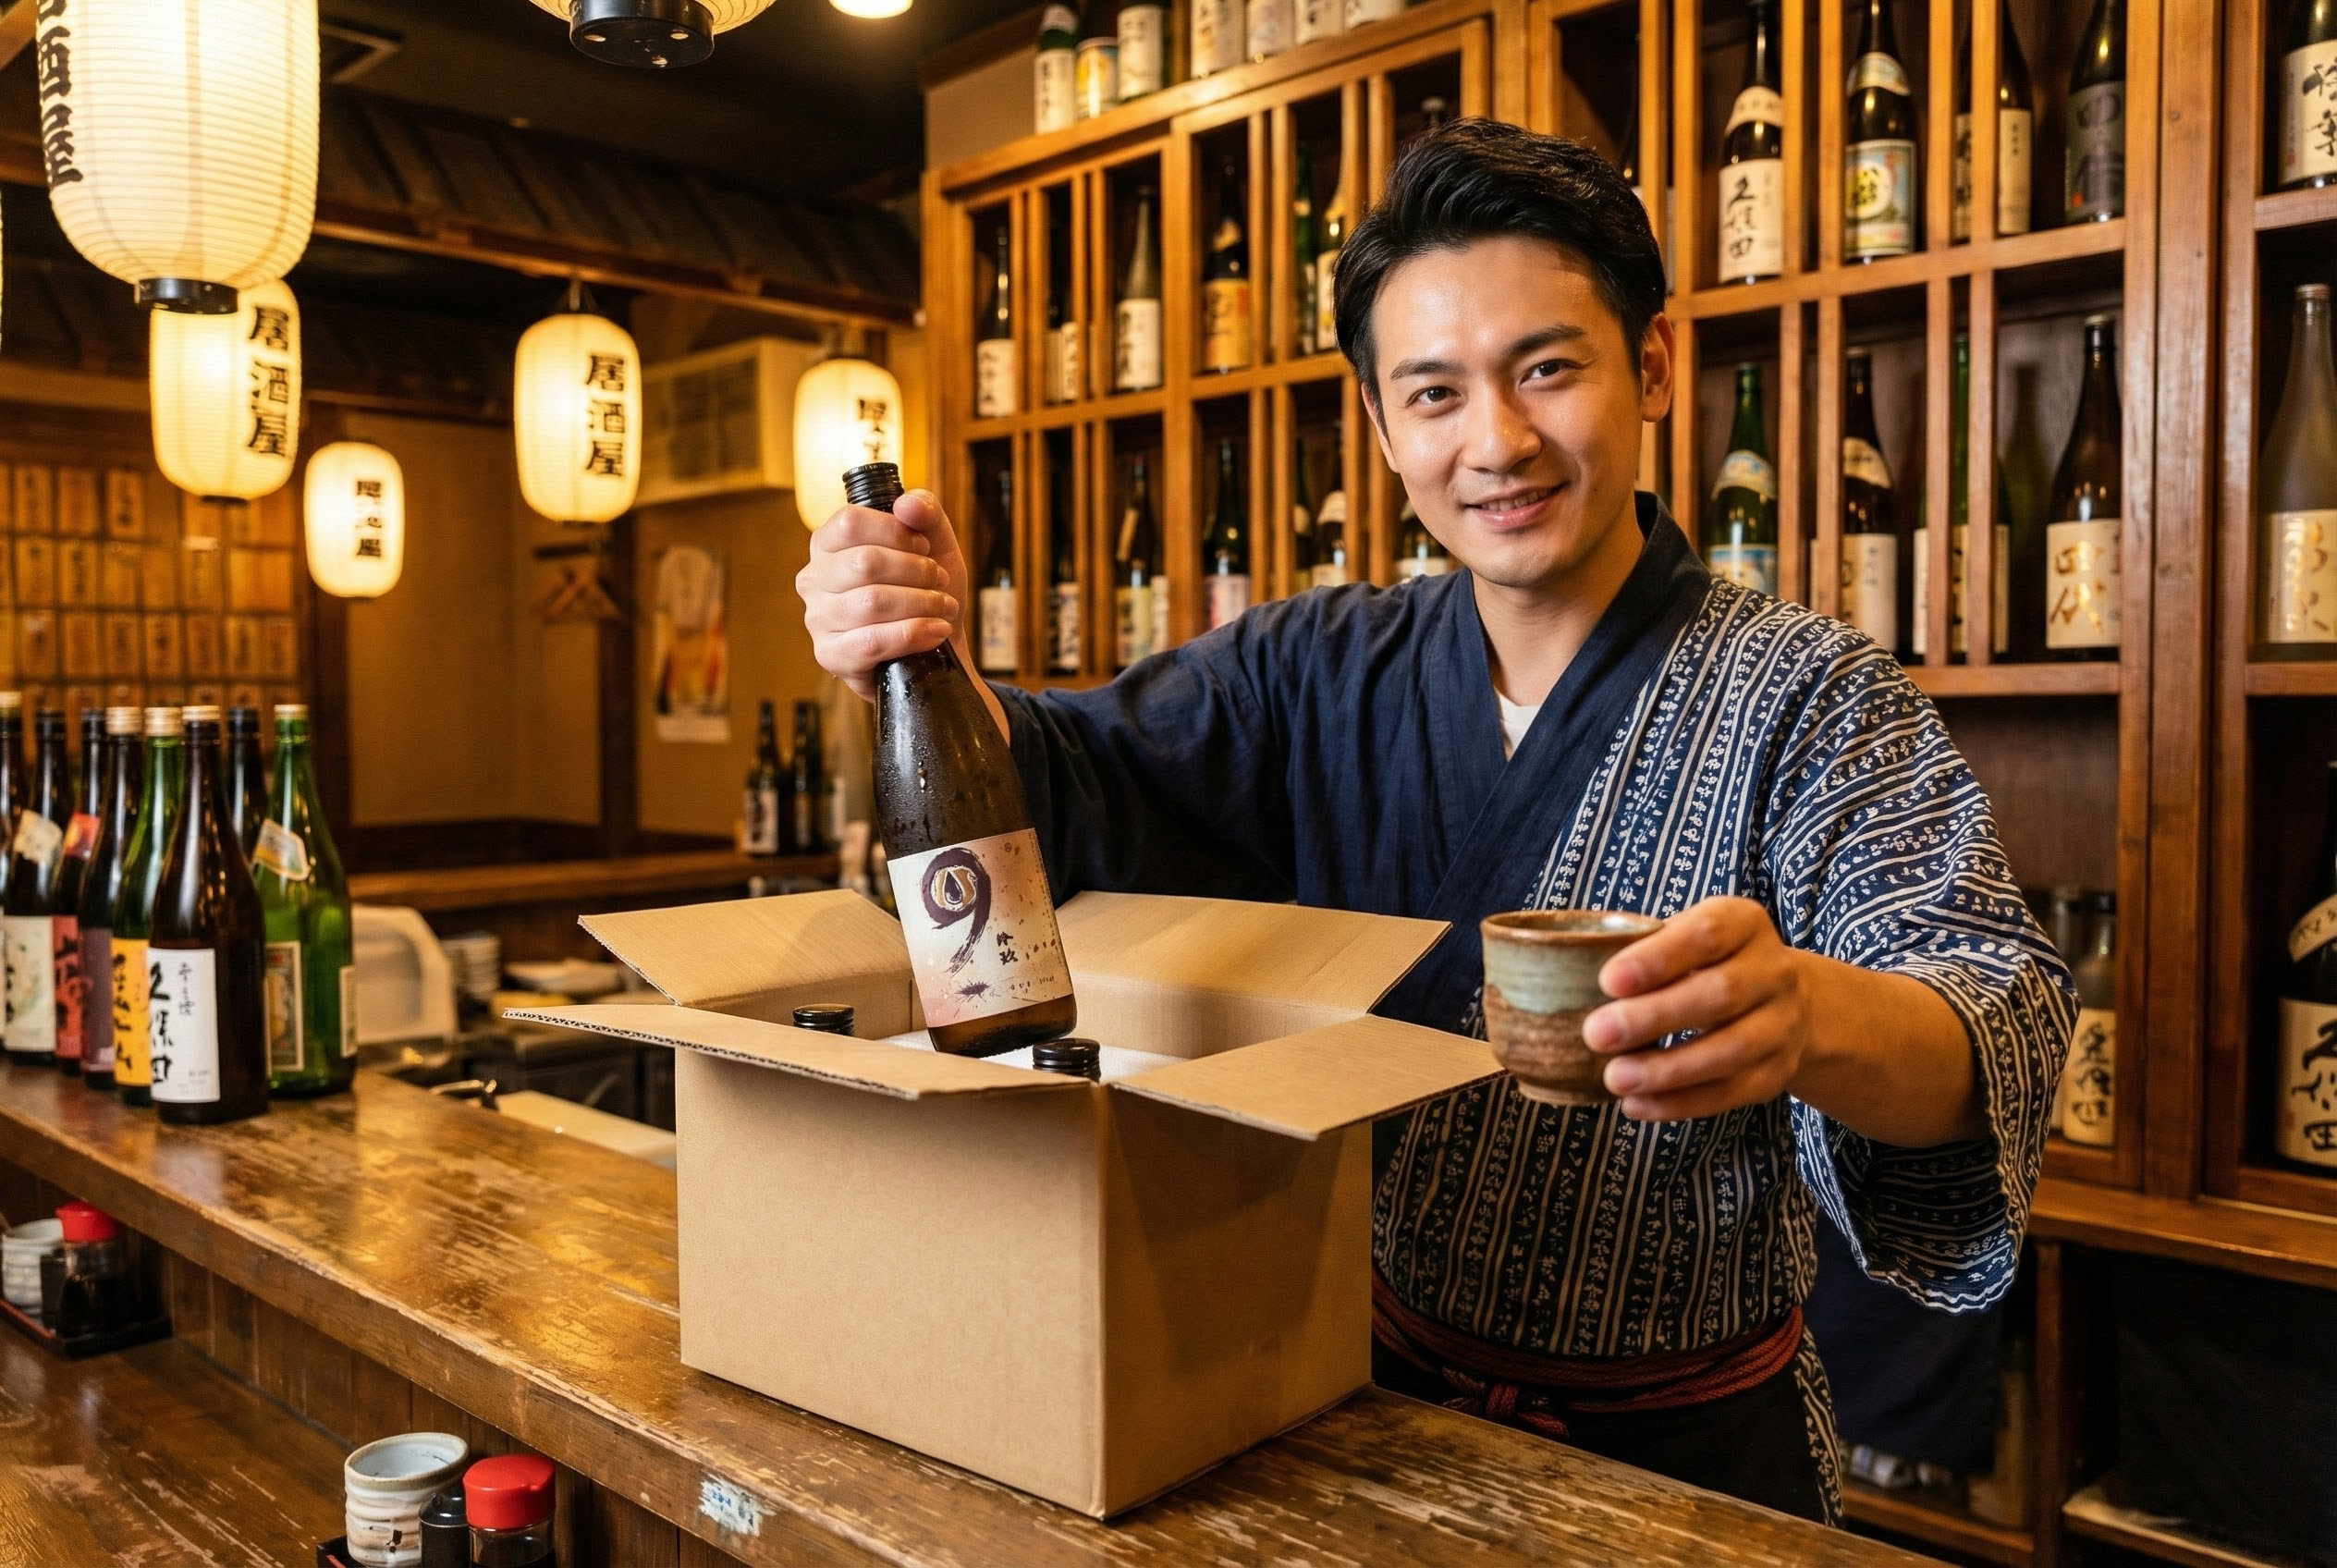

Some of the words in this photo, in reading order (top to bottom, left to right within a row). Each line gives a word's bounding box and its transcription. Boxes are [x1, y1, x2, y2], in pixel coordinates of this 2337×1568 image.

[248, 306, 289, 457] 居酒屋
[585, 354, 626, 477] 居酒屋
